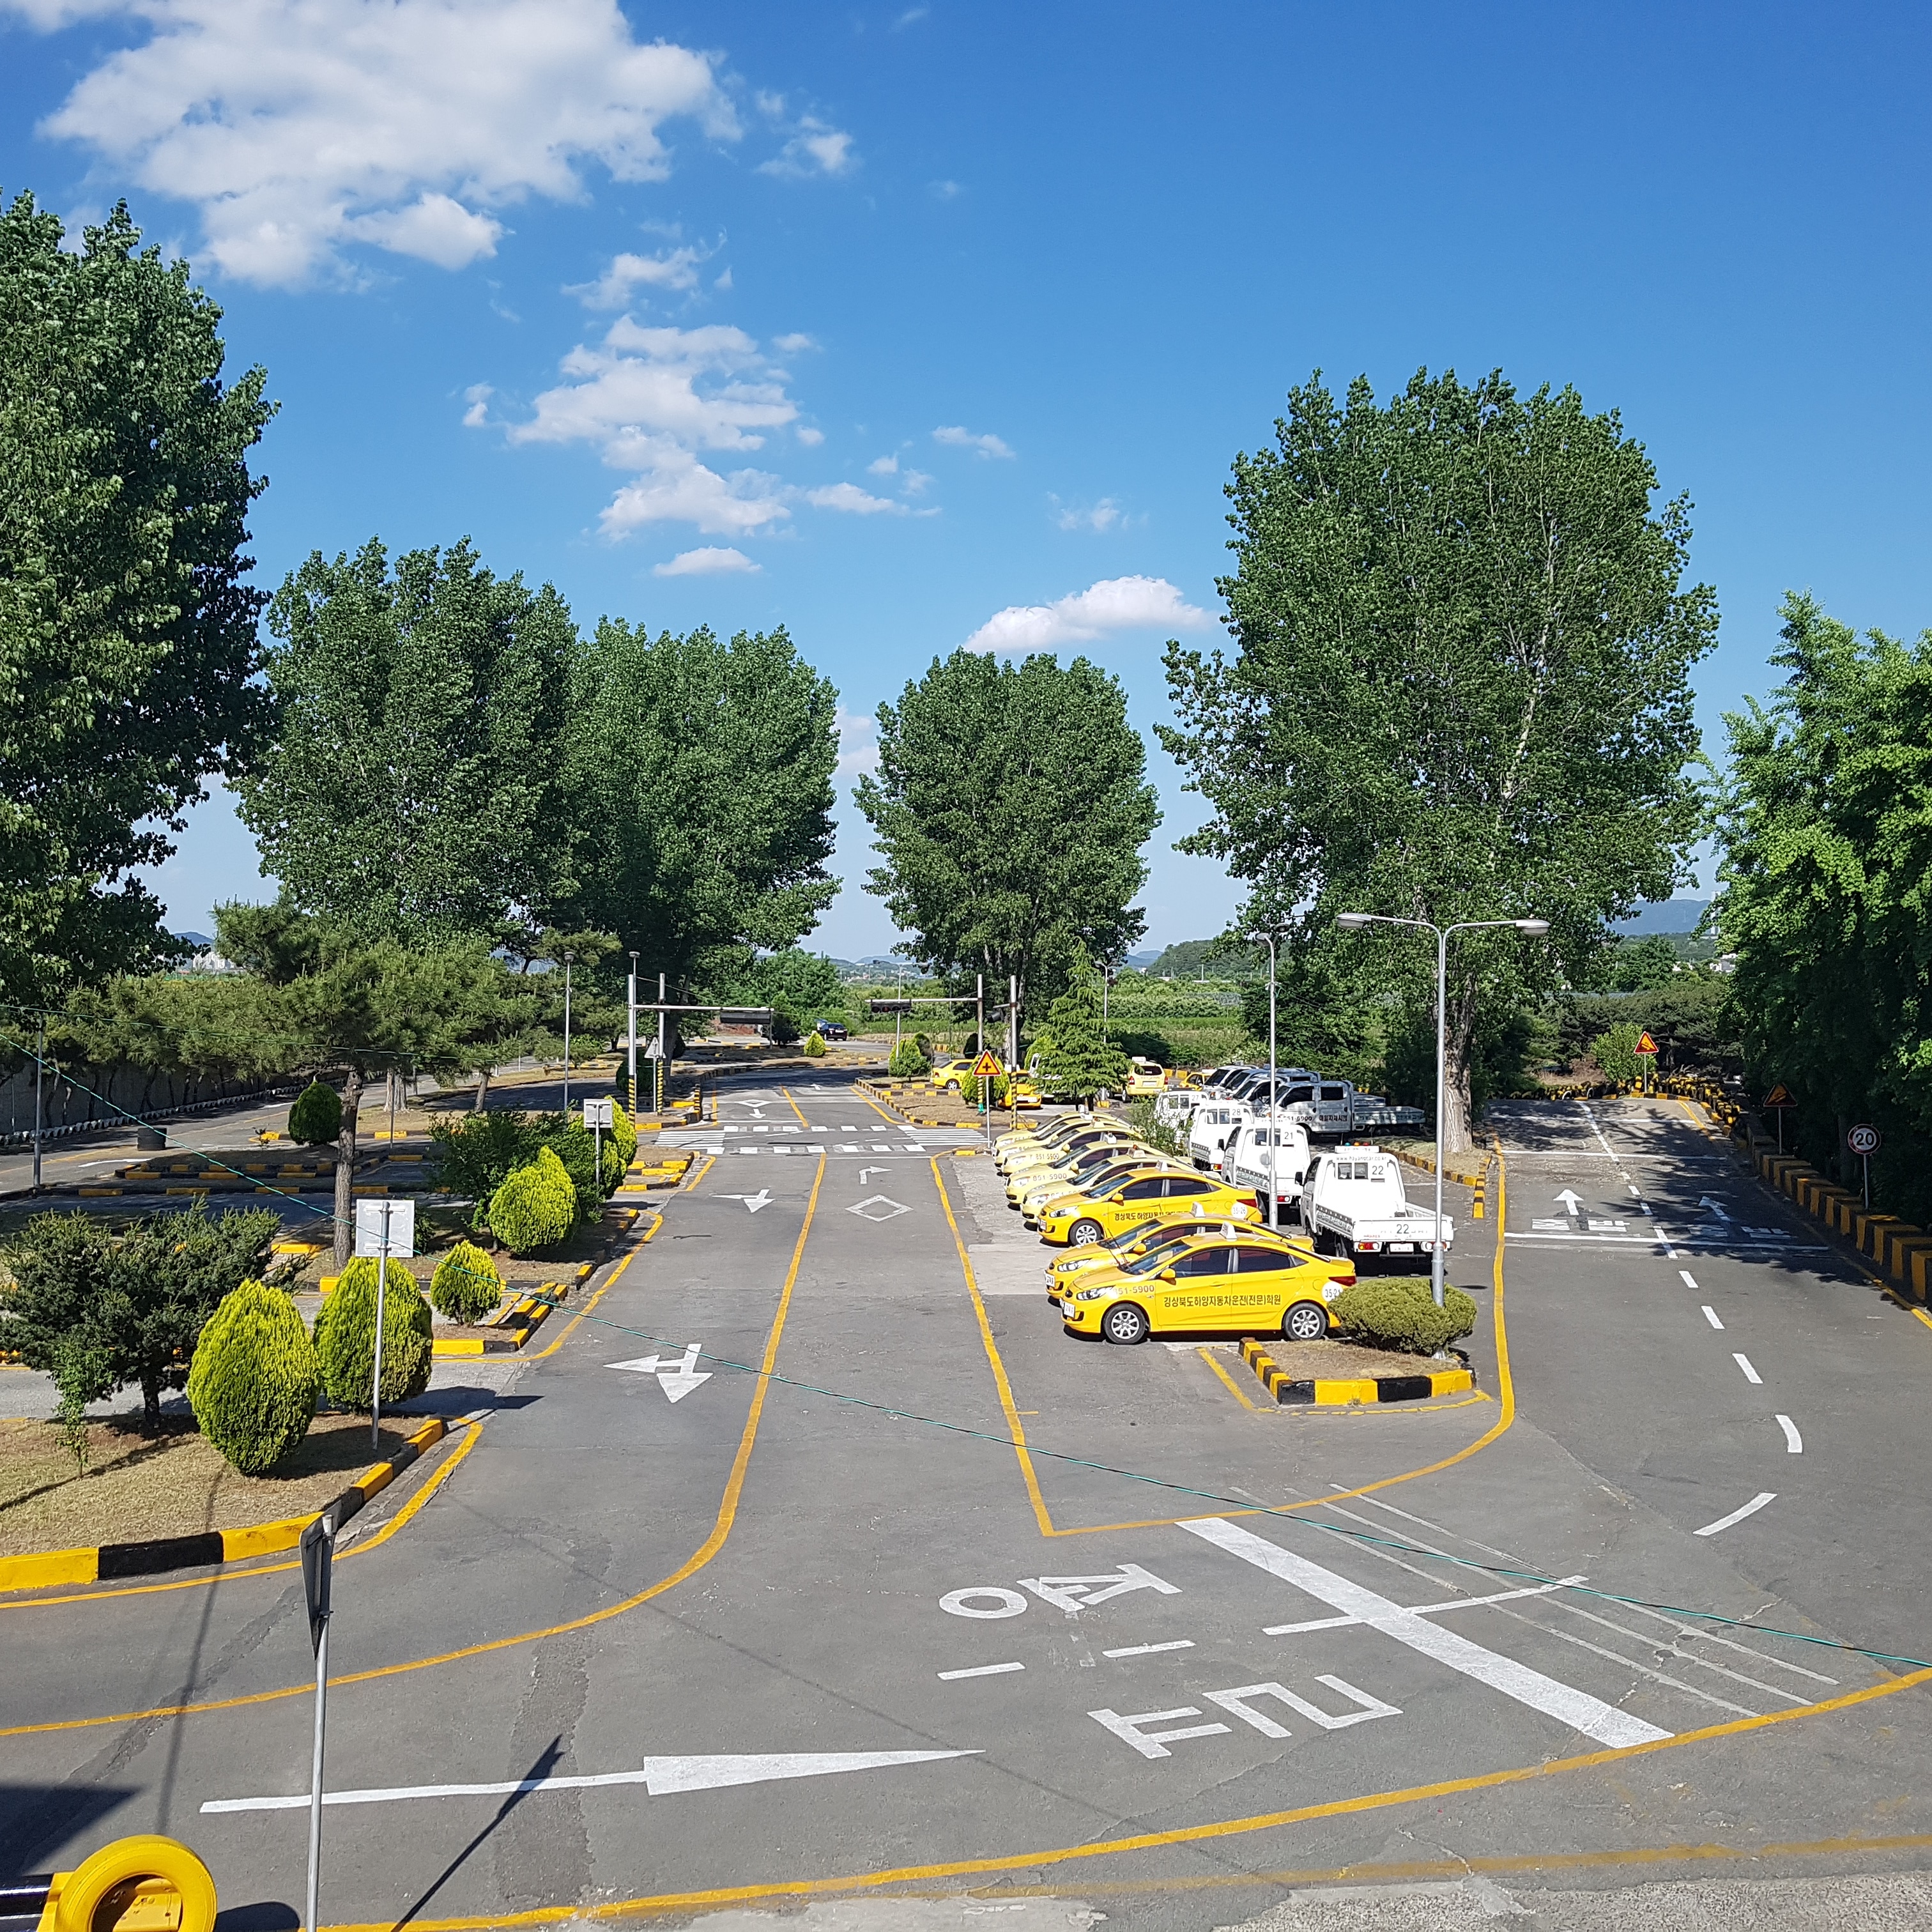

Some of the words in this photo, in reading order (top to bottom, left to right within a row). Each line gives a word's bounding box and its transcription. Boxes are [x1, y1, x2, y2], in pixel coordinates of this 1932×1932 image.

[1284, 1131, 1293, 1140] 21
[1855, 1132, 1874, 1146] 20
[1372, 1165, 1384, 1175] 22
[1396, 1223, 1409, 1234] 22
